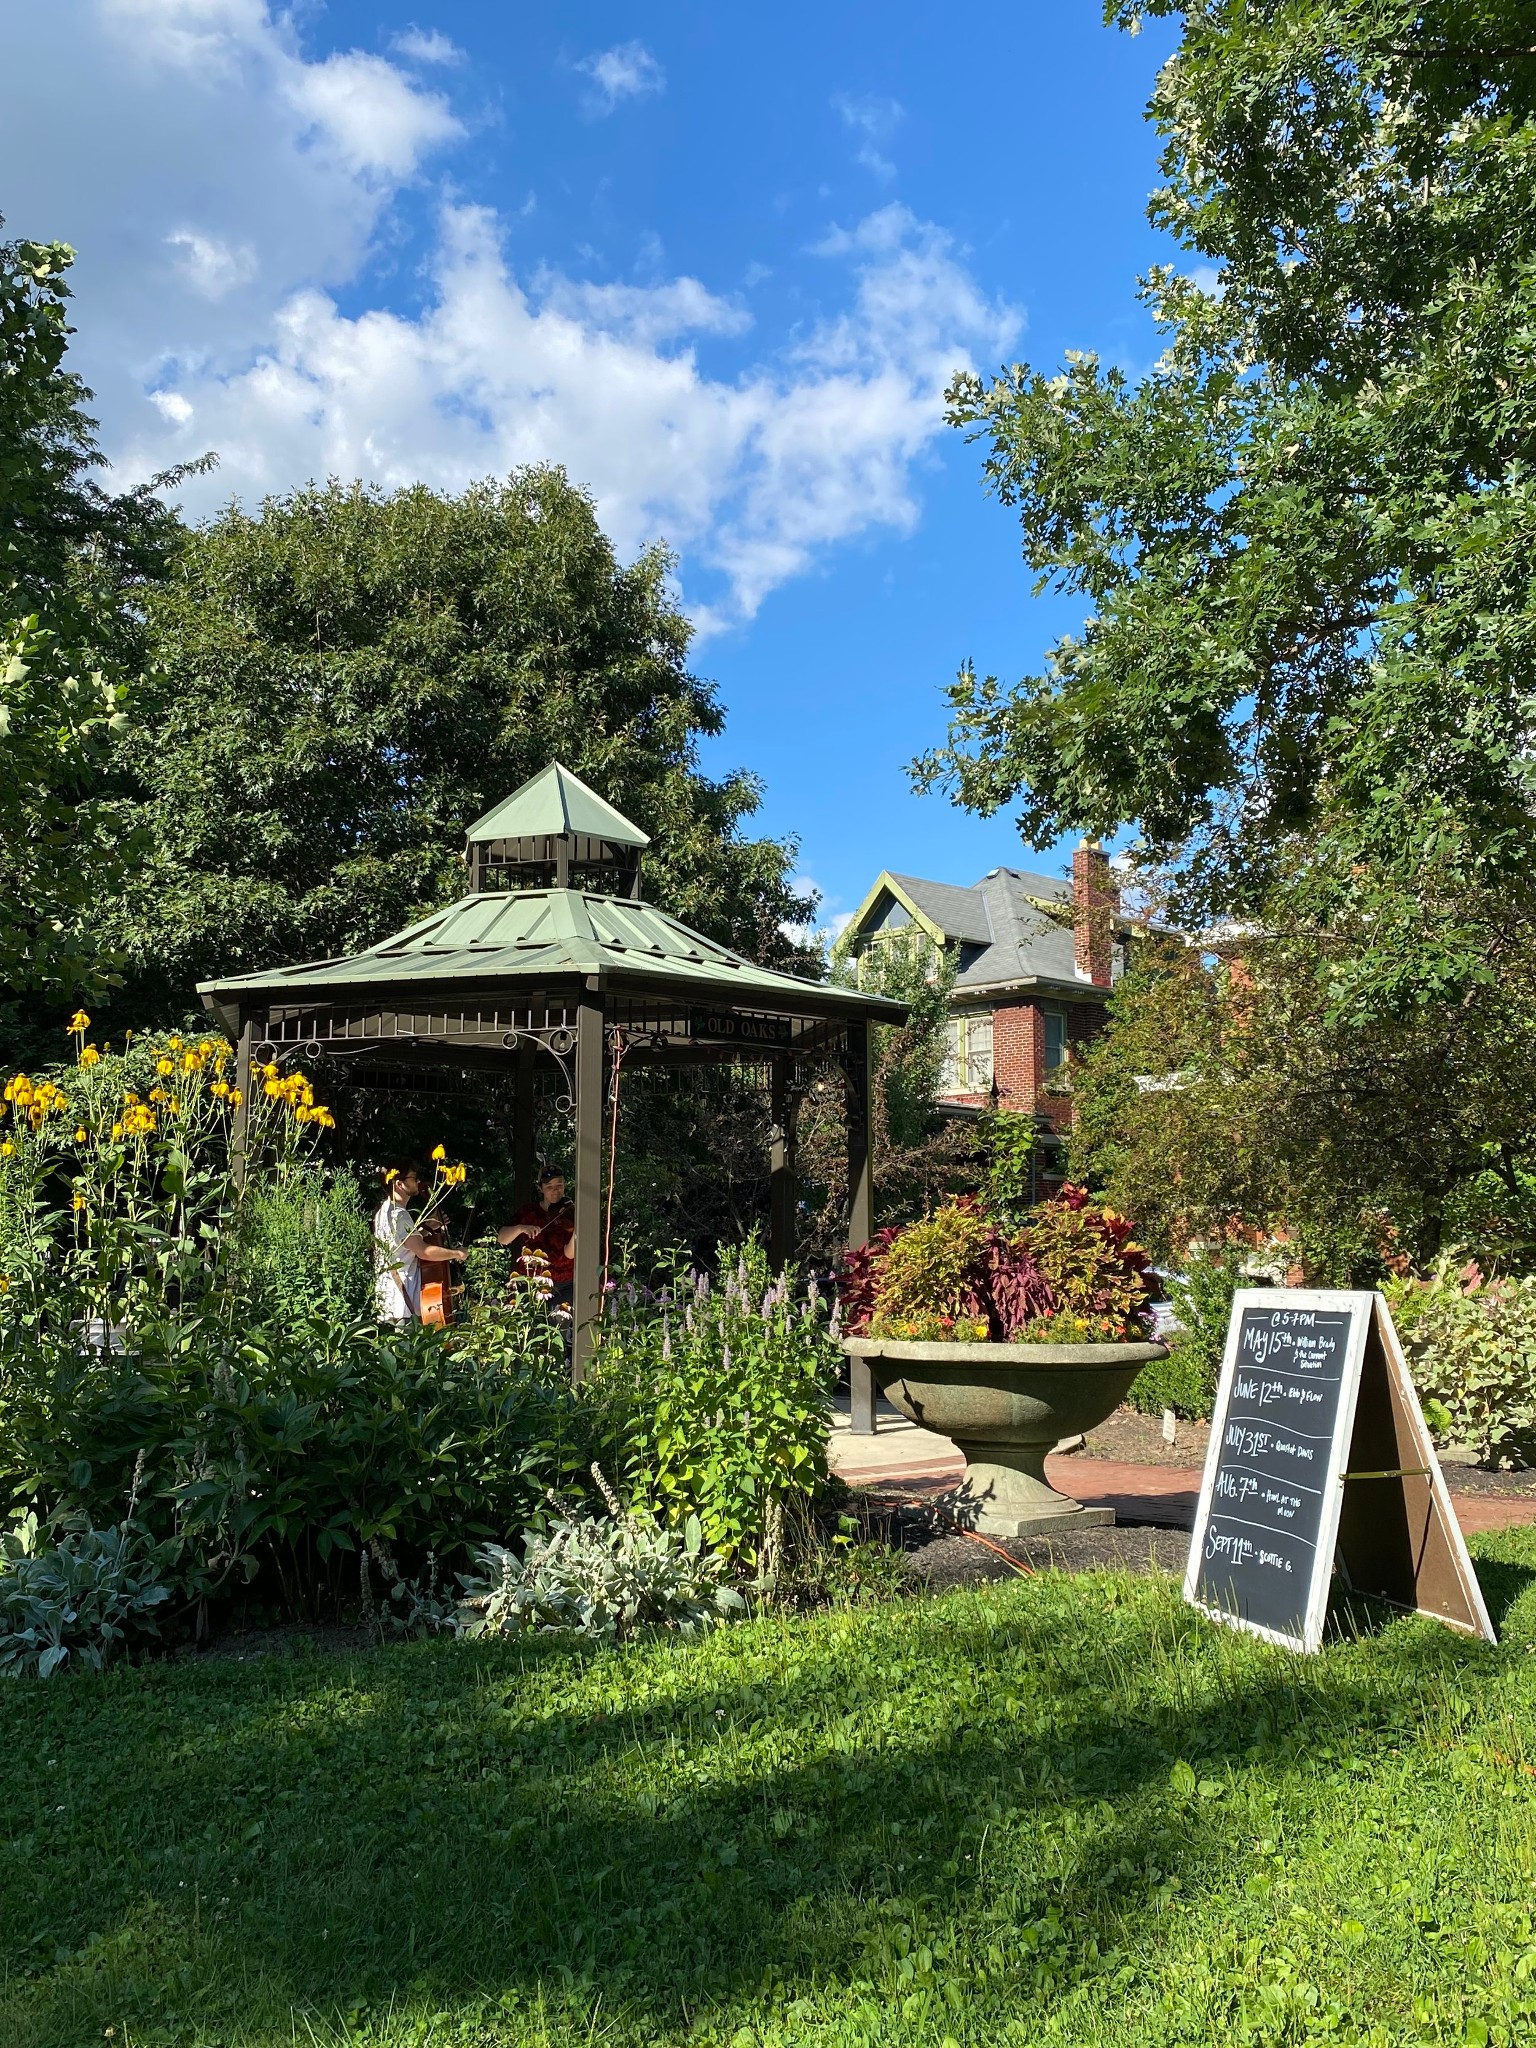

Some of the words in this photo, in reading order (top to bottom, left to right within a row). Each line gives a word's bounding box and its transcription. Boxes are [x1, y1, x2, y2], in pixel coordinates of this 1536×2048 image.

[707, 1017, 735, 1034] OLD
[741, 1021, 776, 1039] OAKS
[1243, 1327, 1269, 1363] MAY
[1318, 1336, 1336, 1352] Brady
[1234, 1374, 1259, 1399] JUNE
[1226, 1424, 1247, 1455] JULY
